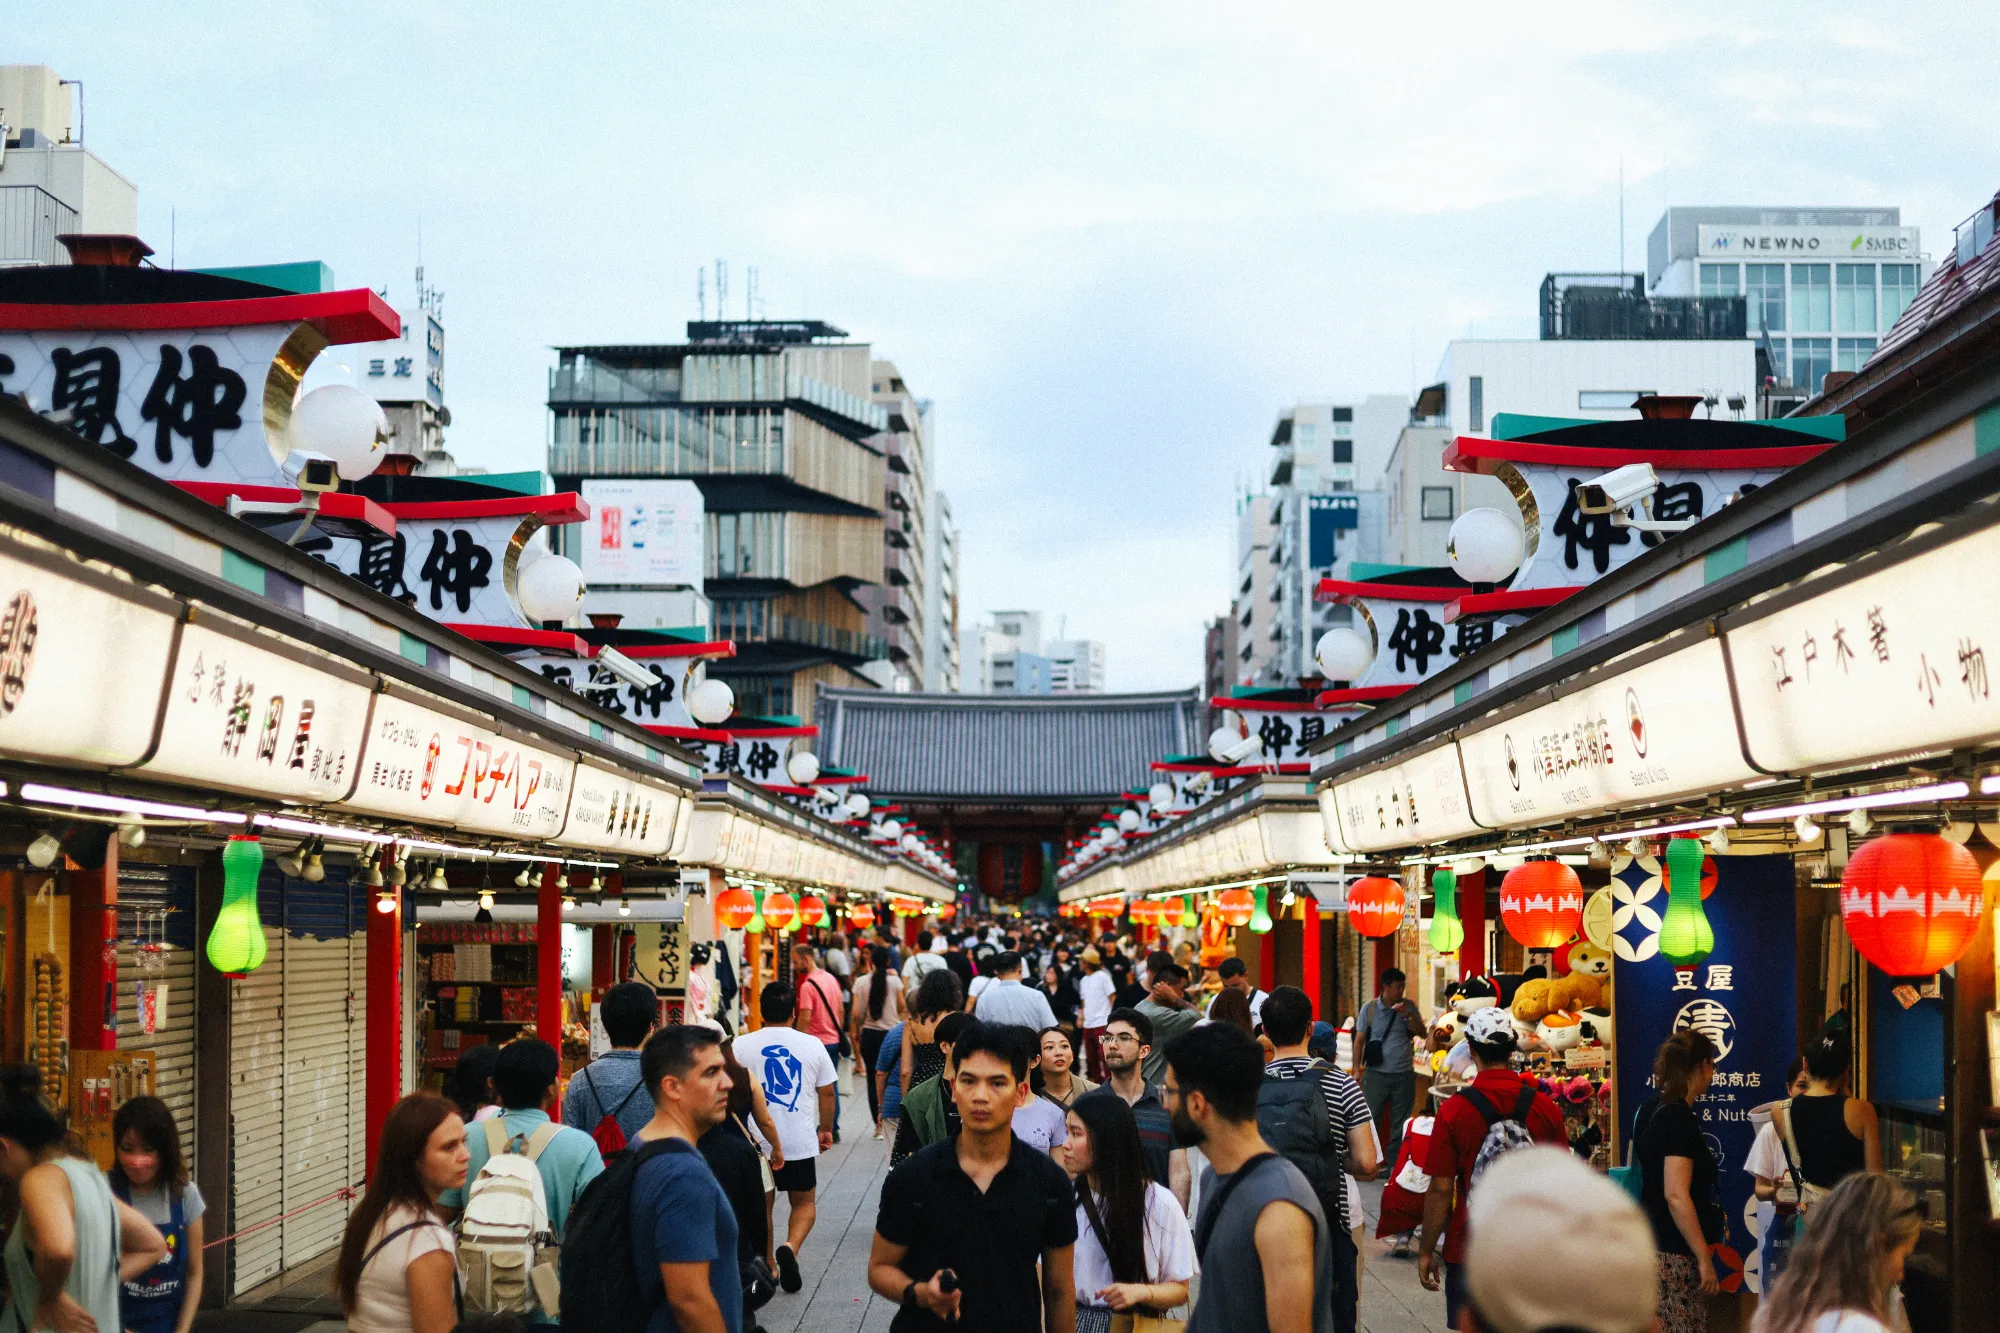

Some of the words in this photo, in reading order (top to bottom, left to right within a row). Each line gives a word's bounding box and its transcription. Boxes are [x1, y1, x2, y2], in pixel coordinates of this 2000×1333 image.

[1743, 236, 1820, 249] NEWNO
[1866, 236, 1907, 250] SMBC
[368, 356, 413, 378] 三定
[0, 344, 247, 468] 仲見
[1917, 637, 1989, 709] 小物
[220, 674, 316, 770] 静岡屋
[444, 735, 542, 811] コマチヘア
[1671, 964, 1735, 991] 豆屋
[1702, 1108, 1713, 1122] &
[124, 1281, 152, 1294] HELLO
[153, 1280, 179, 1292] KITTY
